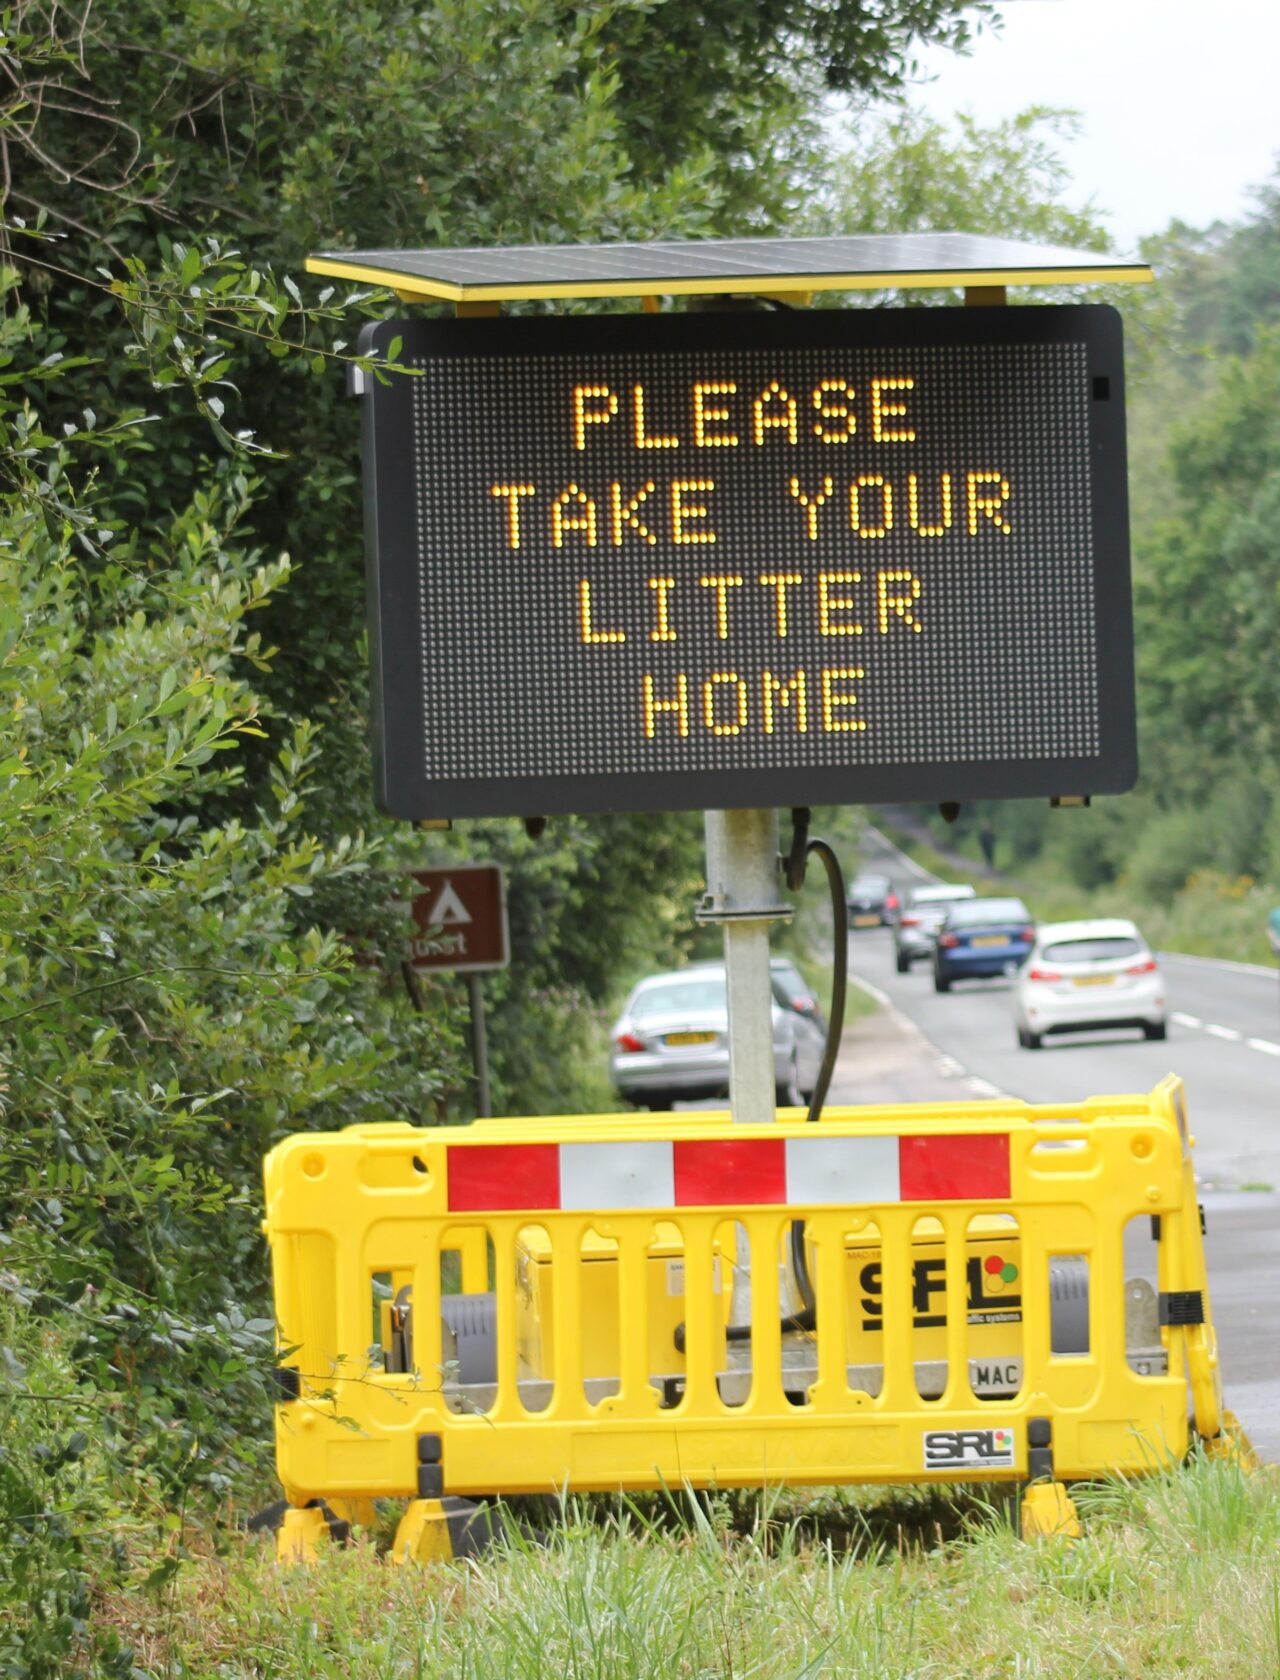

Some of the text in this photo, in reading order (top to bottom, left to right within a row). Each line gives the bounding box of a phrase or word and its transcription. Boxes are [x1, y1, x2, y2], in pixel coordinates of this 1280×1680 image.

[573, 378, 916, 451] PLEASE
[491, 471, 1012, 549] TAKE YOUR
[578, 569, 923, 644] LITTER
[643, 667, 867, 738] HOME
[976, 1364, 1018, 1386] MAC
[926, 1431, 1011, 1459] SRL
